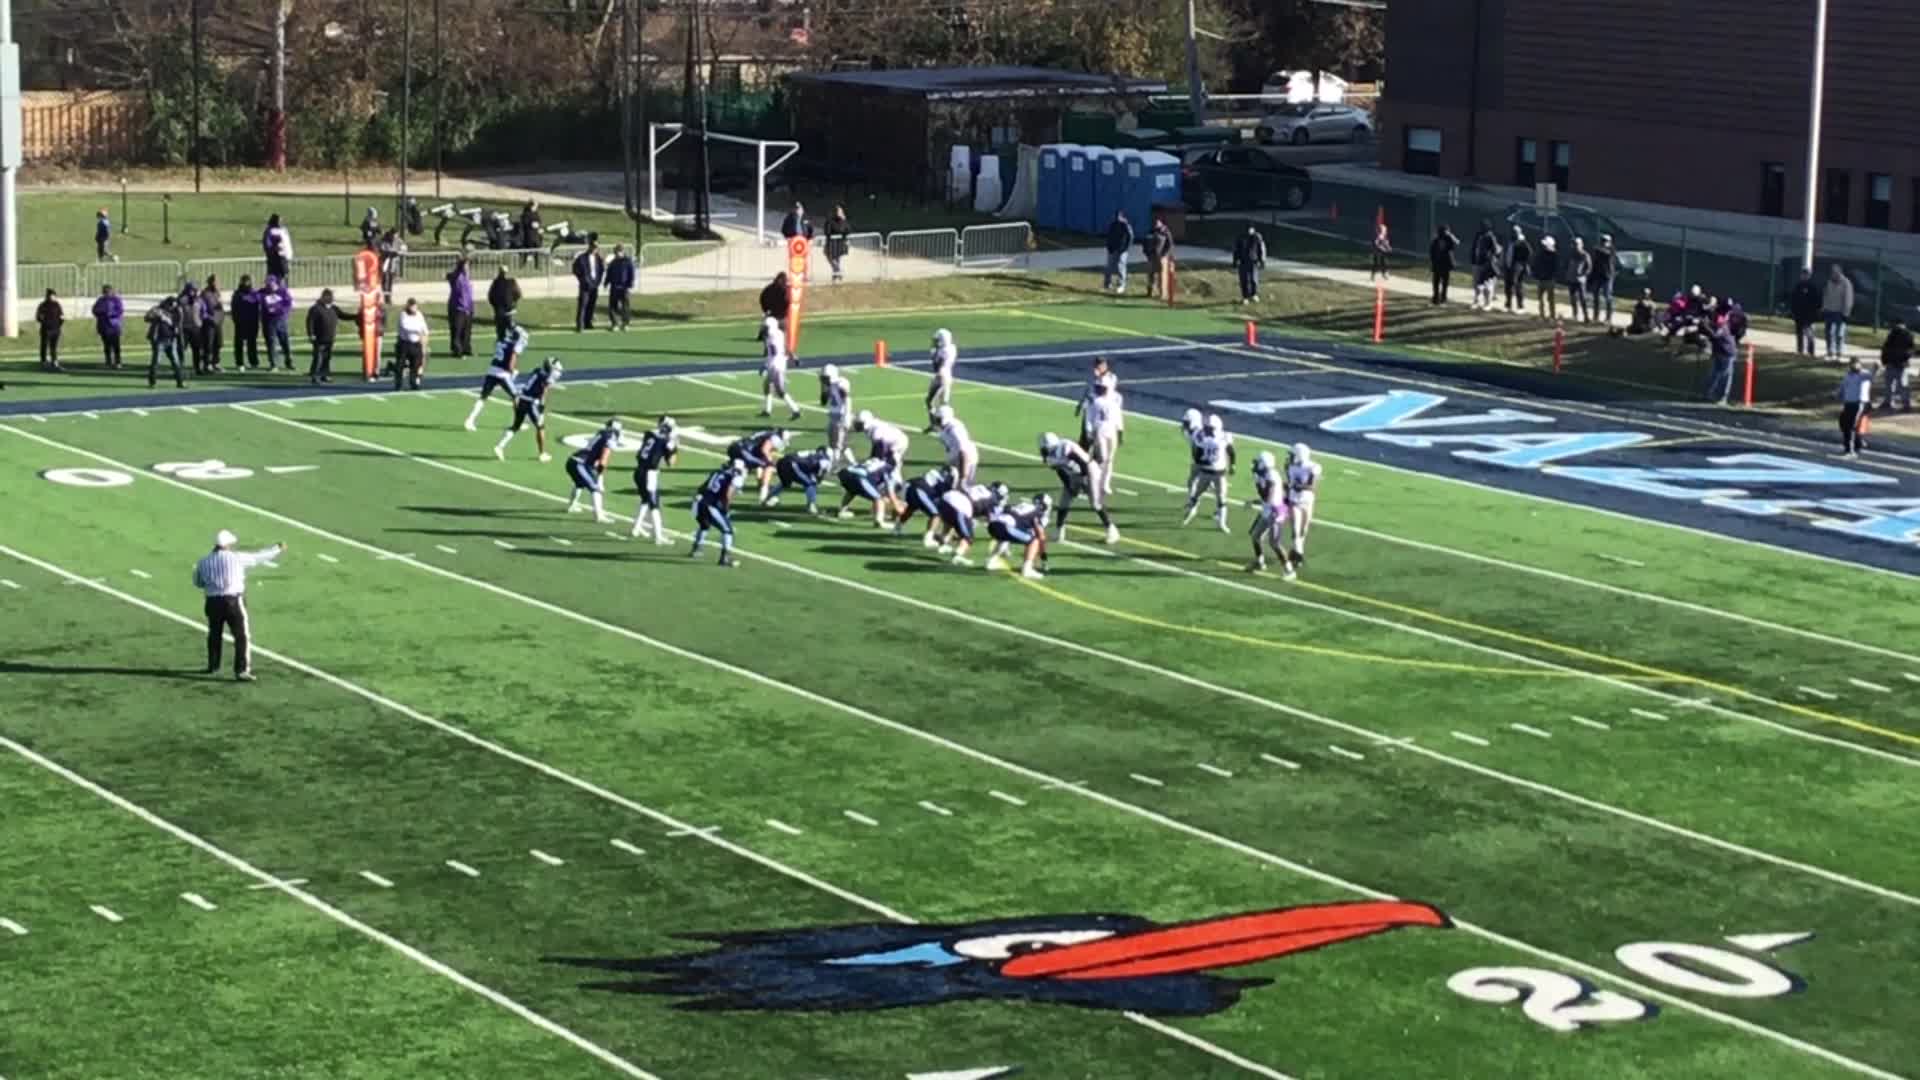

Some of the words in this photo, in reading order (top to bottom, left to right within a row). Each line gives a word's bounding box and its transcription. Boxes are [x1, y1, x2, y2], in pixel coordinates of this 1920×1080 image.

[641, 437, 655, 459] 2
[1208, 389, 1920, 547] NAZA
[1446, 940, 1793, 1032] 20
